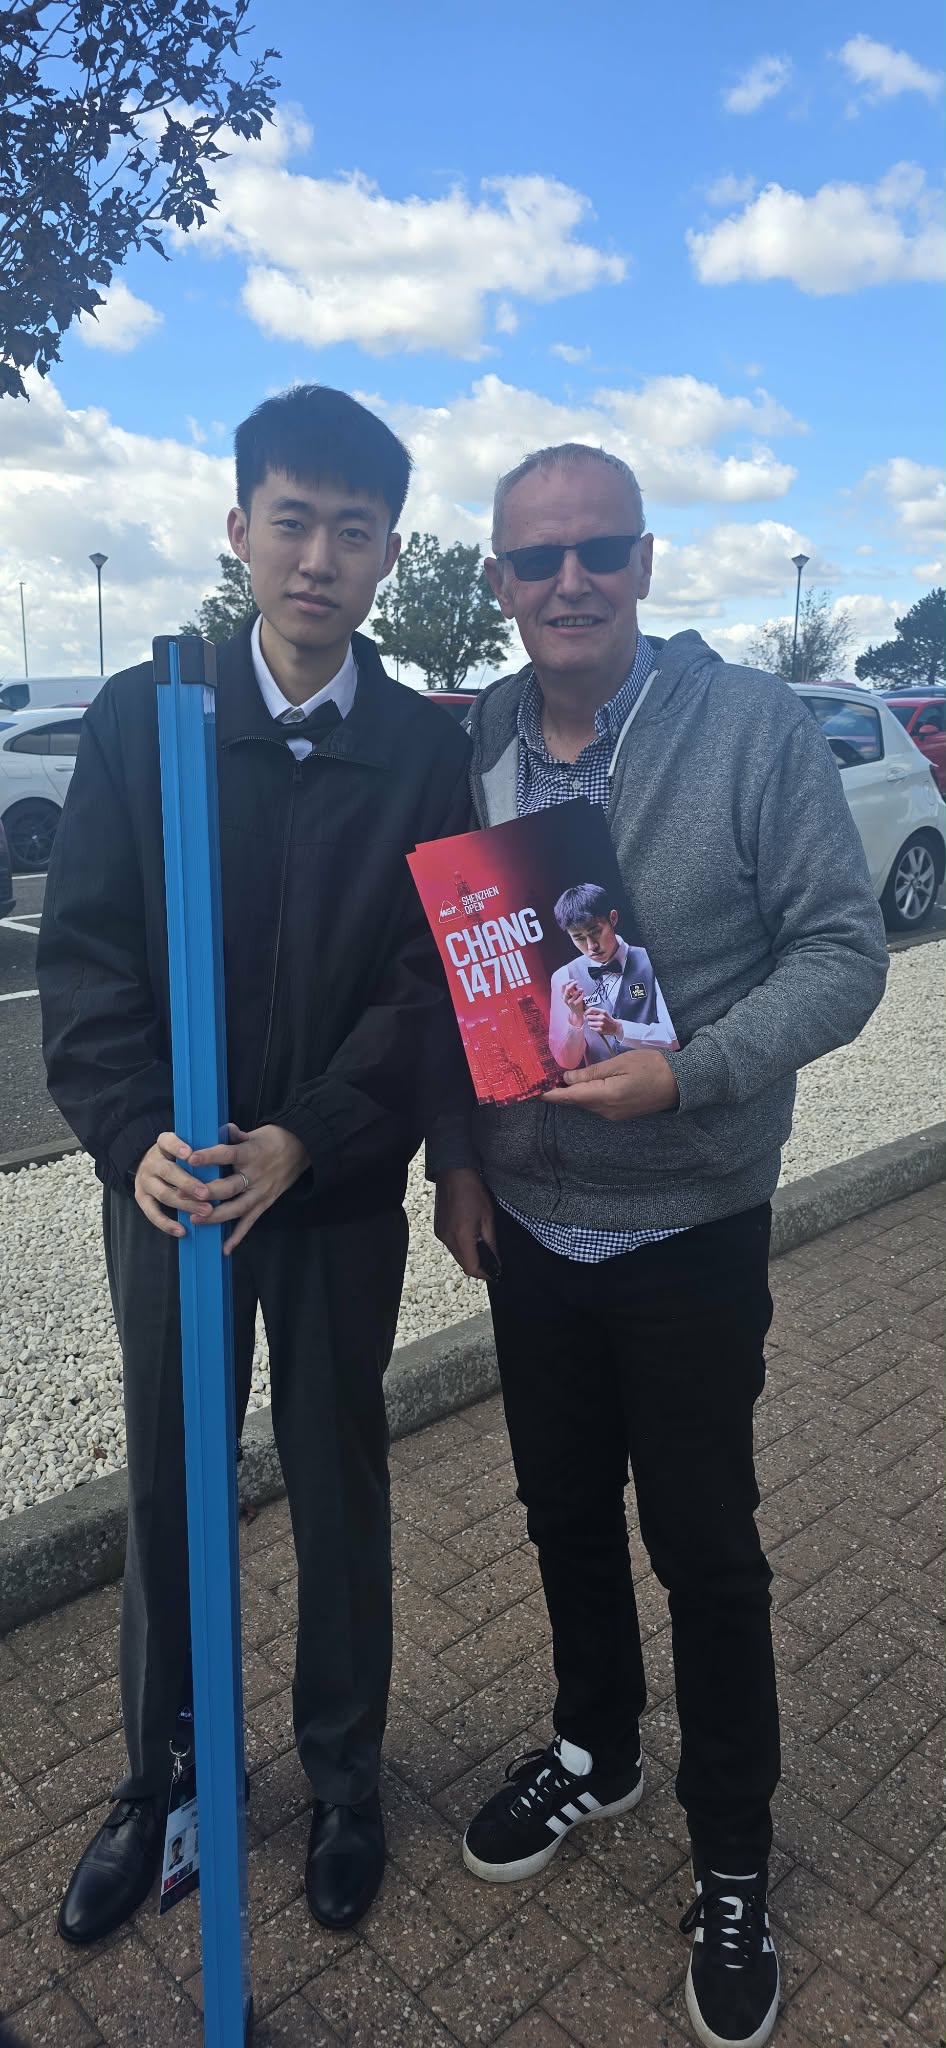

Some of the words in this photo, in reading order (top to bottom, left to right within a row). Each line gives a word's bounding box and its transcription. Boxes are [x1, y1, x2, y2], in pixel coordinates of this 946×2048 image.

[461, 885, 500, 906] SHENZHEN
[439, 905, 457, 918] WST
[464, 900, 485, 915] OPEN
[445, 907, 544, 967] CHANG
[456, 949, 532, 1003] 147!!!
